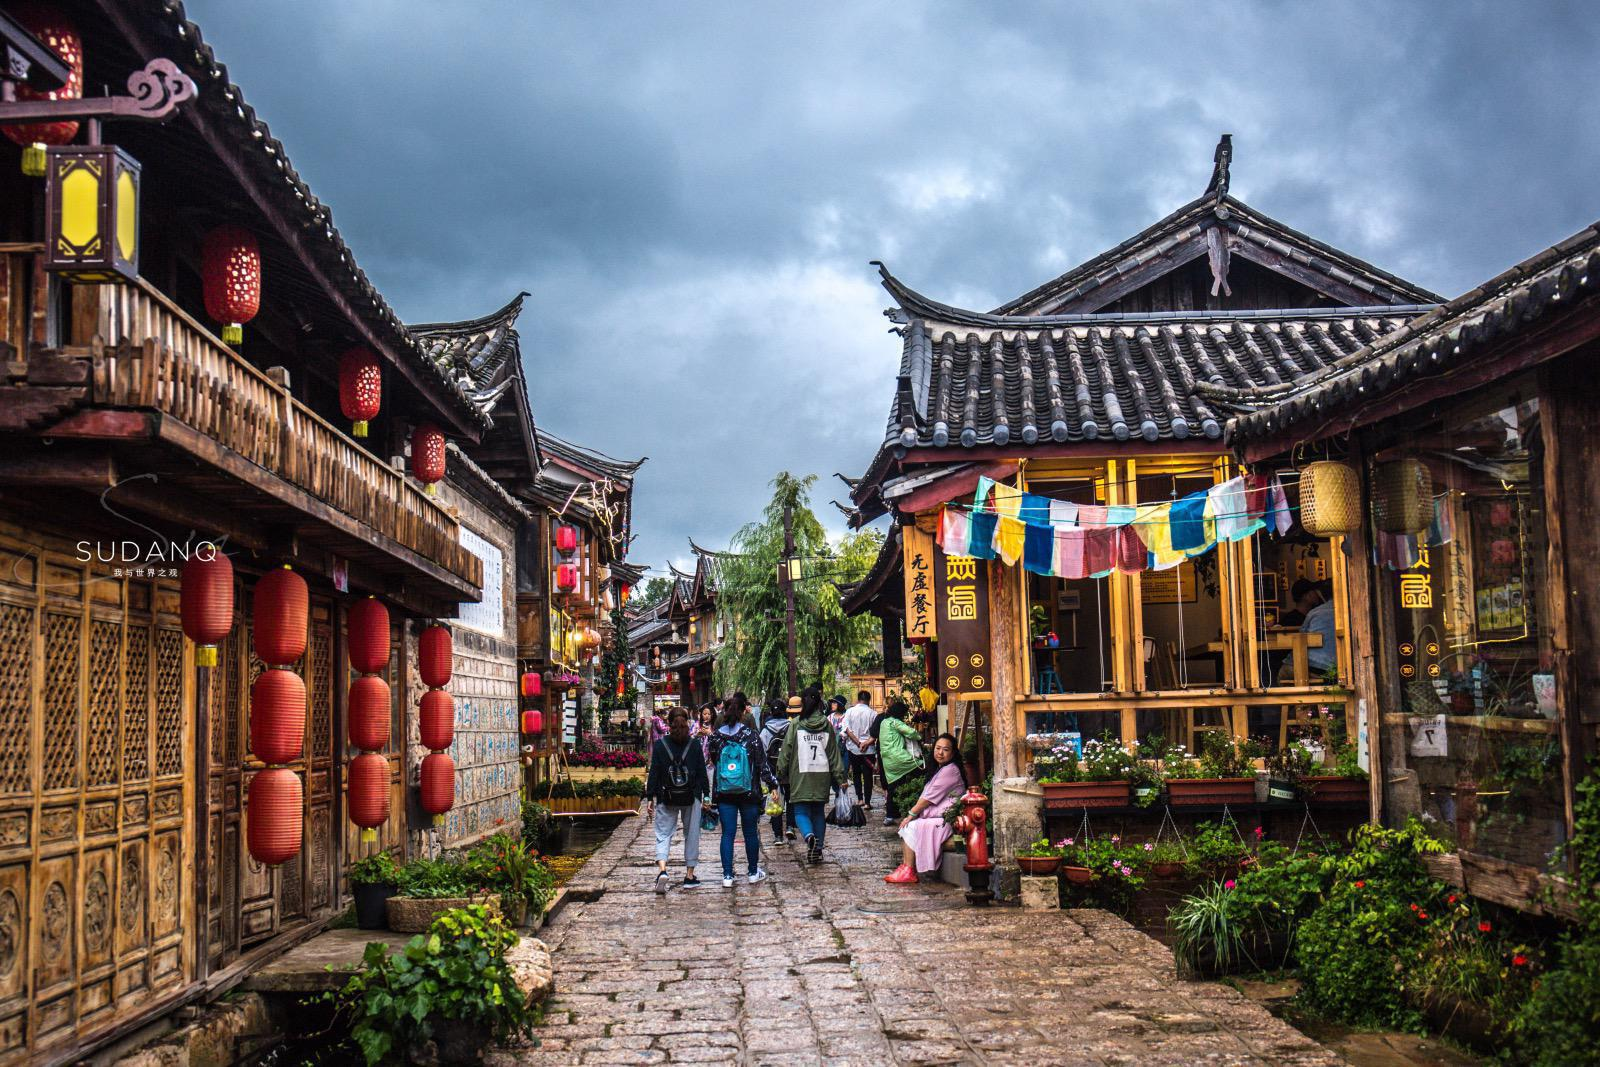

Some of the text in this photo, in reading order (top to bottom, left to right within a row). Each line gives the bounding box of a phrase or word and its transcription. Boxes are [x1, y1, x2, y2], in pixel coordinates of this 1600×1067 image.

[911, 554, 932, 634] 无虚餐厅
[810, 745, 818, 760] 7
